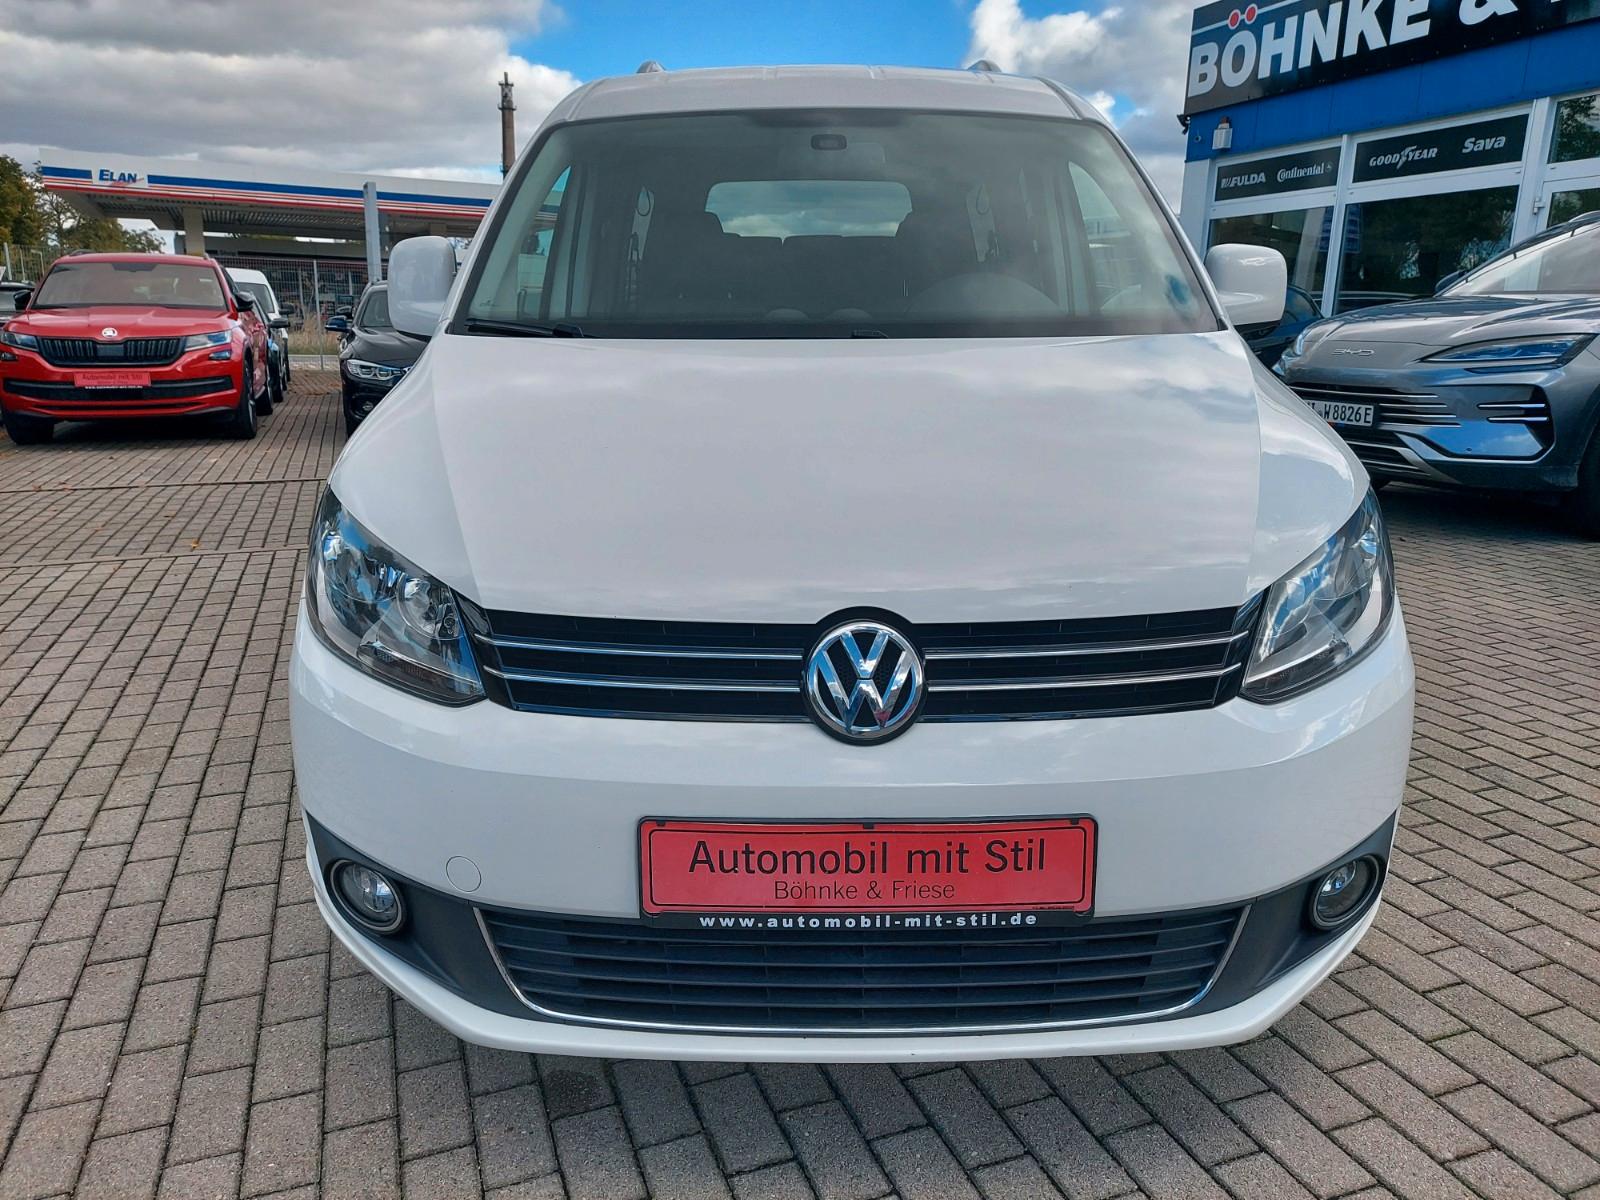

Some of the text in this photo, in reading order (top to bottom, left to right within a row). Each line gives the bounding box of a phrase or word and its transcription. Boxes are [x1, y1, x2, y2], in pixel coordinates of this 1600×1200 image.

[1462, 136, 1506, 153] Sava
[1369, 145, 1438, 170] GOODYEAR
[99, 169, 137, 183] ELAN
[1230, 172, 1266, 187] FULDA
[1277, 162, 1325, 183] Continental
[688, 838, 1045, 874] Automobil mit Stil
[774, 880, 955, 900] Böhnke & Friese
[699, 913, 1037, 929] www.automobil-mit-stil.de
